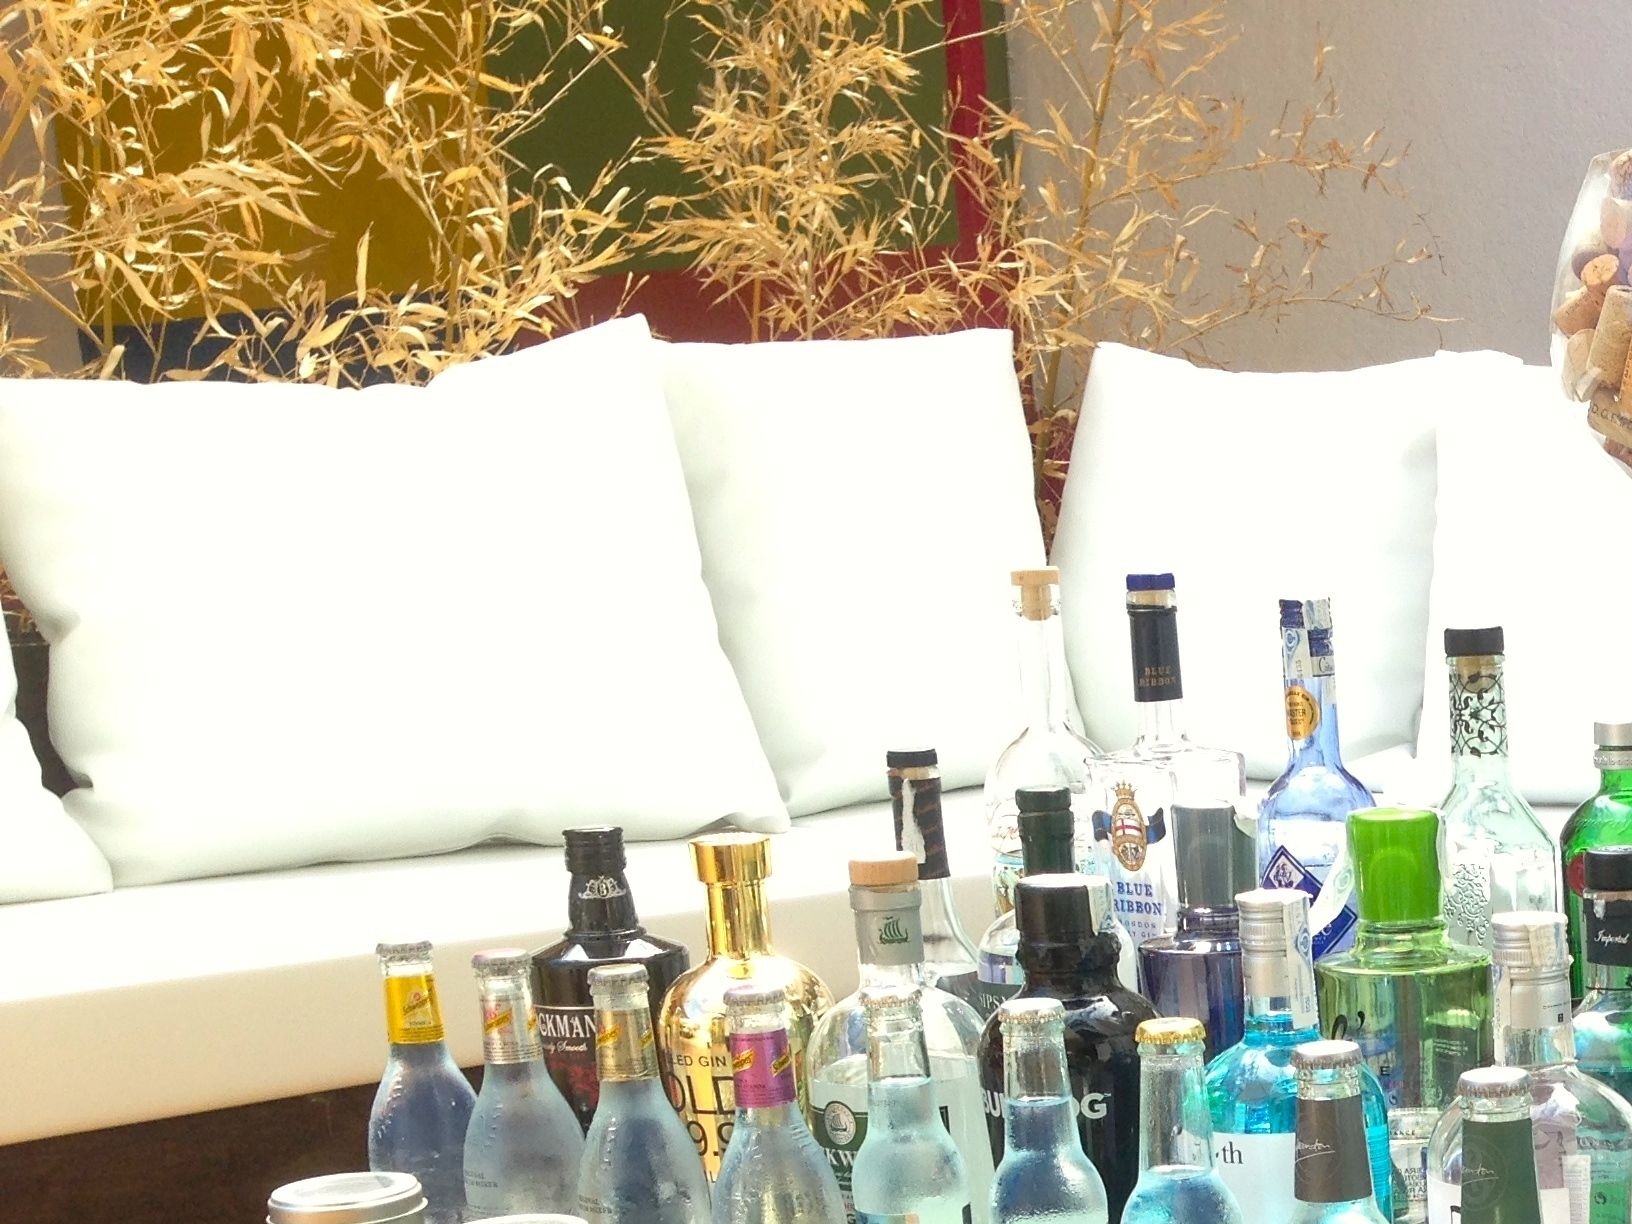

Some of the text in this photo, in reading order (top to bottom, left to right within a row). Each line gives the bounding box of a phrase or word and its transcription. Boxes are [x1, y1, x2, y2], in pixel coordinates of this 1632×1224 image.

[1117, 881, 1153, 897] BLUE
[1113, 899, 1162, 915] RIBBON
[698, 1054, 727, 1067] GIN
